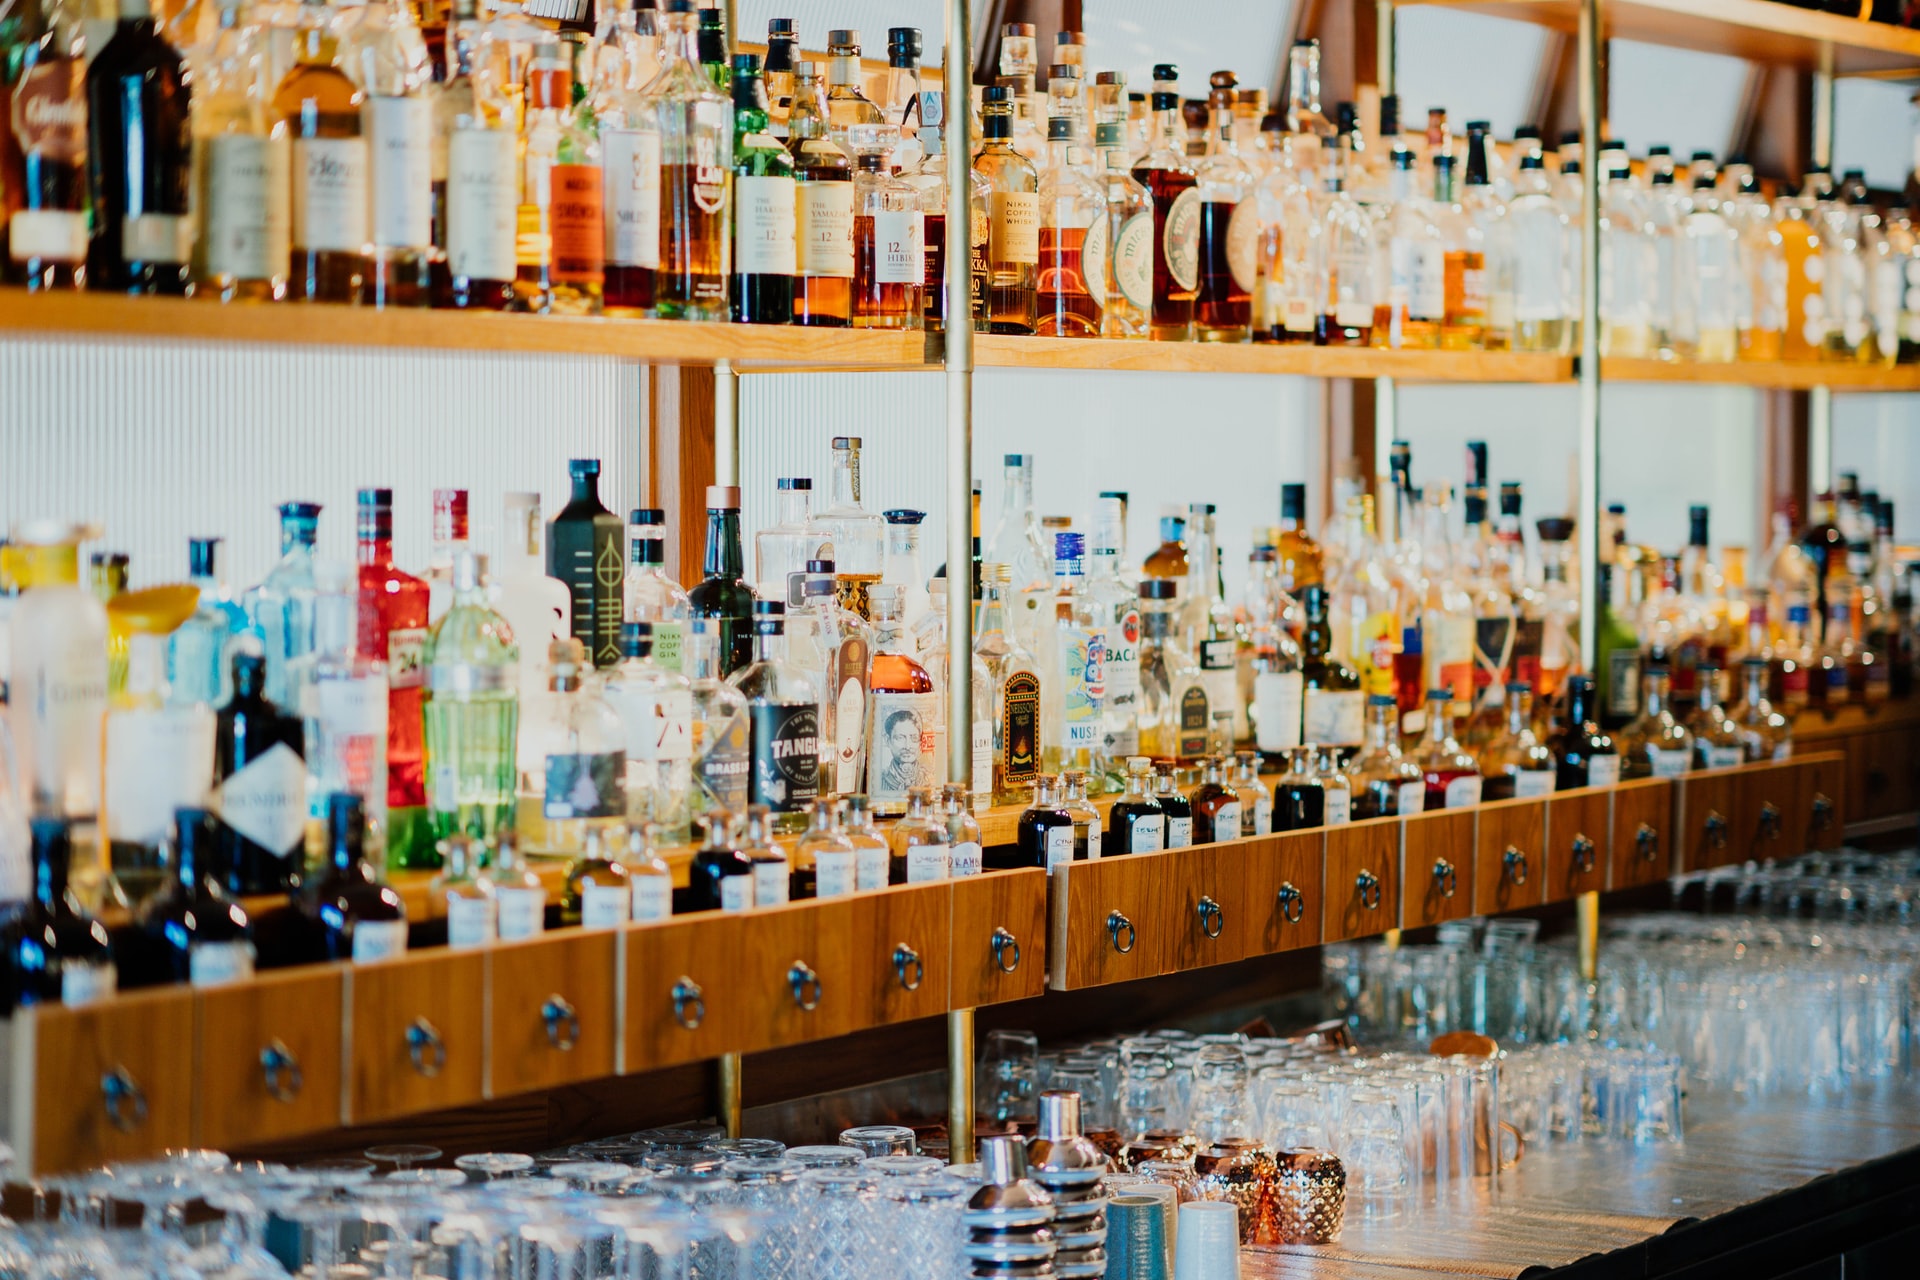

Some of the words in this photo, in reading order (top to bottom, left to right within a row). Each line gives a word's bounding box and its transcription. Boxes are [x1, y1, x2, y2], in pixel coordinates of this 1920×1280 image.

[766, 229, 777, 240] 12
[821, 231, 832, 242] 12
[888, 241, 901, 253] 12
[887, 254, 917, 262] HIBIK
[1010, 702, 1035, 714] NEISSON
